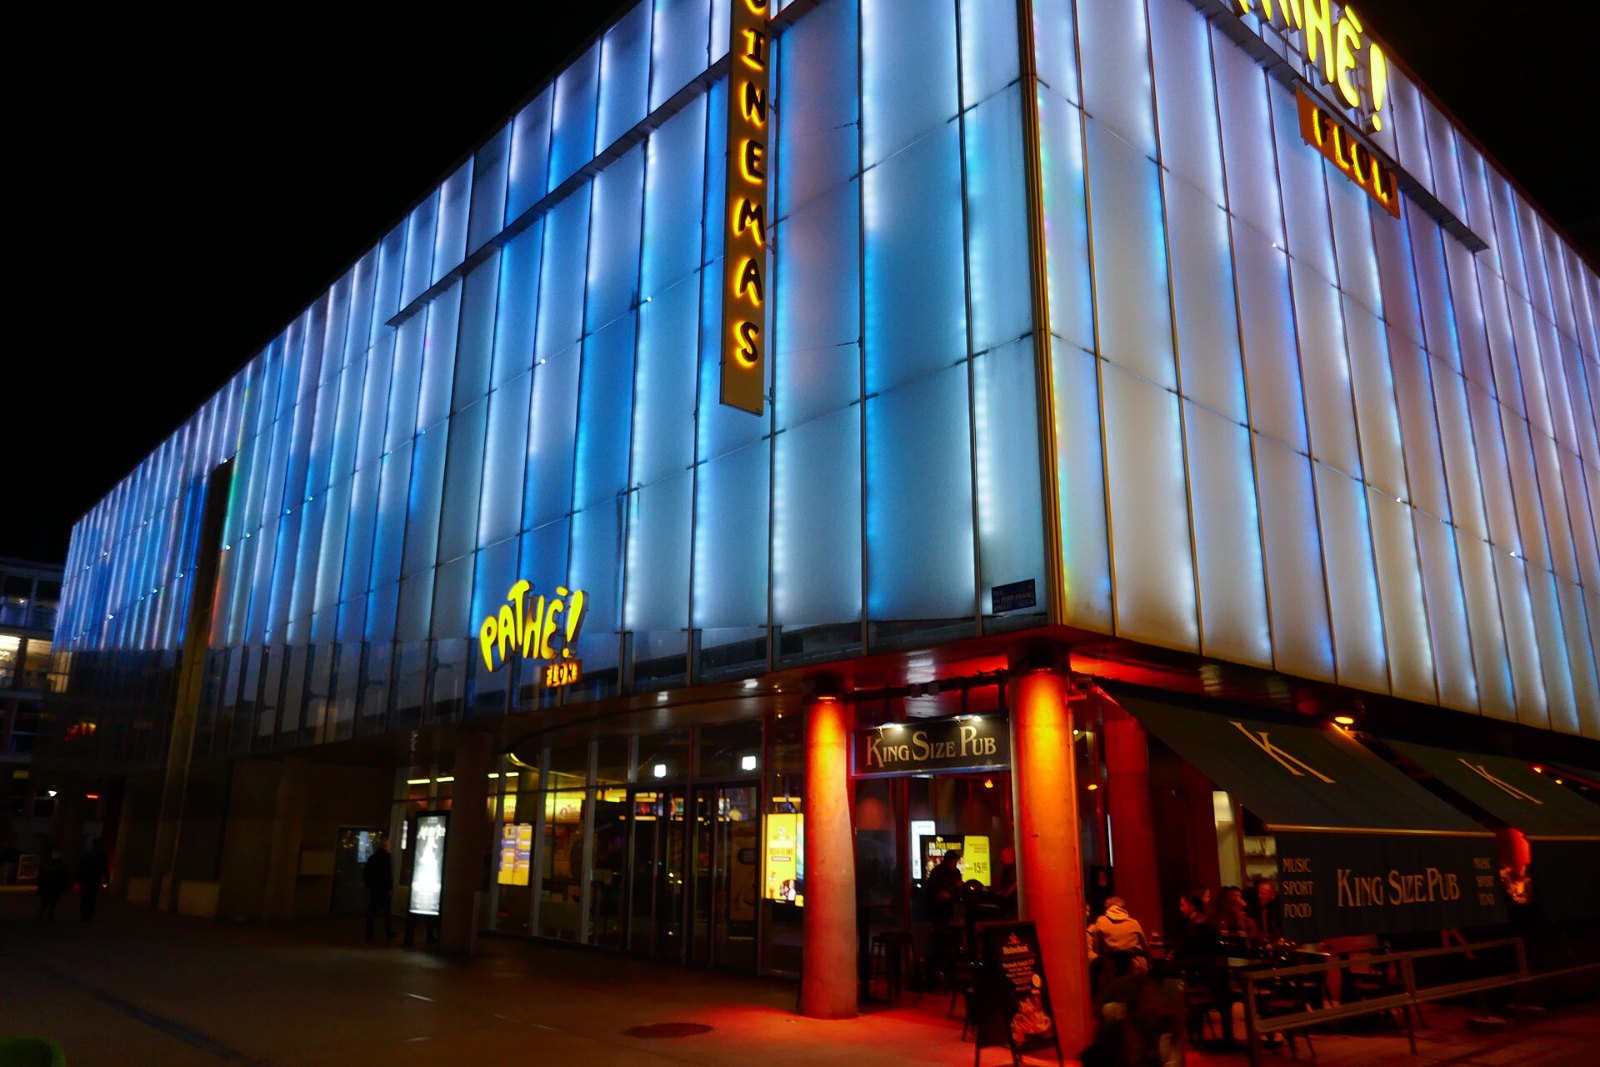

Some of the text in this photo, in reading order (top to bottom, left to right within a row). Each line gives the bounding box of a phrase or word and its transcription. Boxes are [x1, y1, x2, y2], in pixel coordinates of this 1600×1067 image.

[1283, 858, 1312, 873] MUSIC
[1282, 880, 1315, 896] SPORT
[1284, 902, 1313, 918] FOOD
